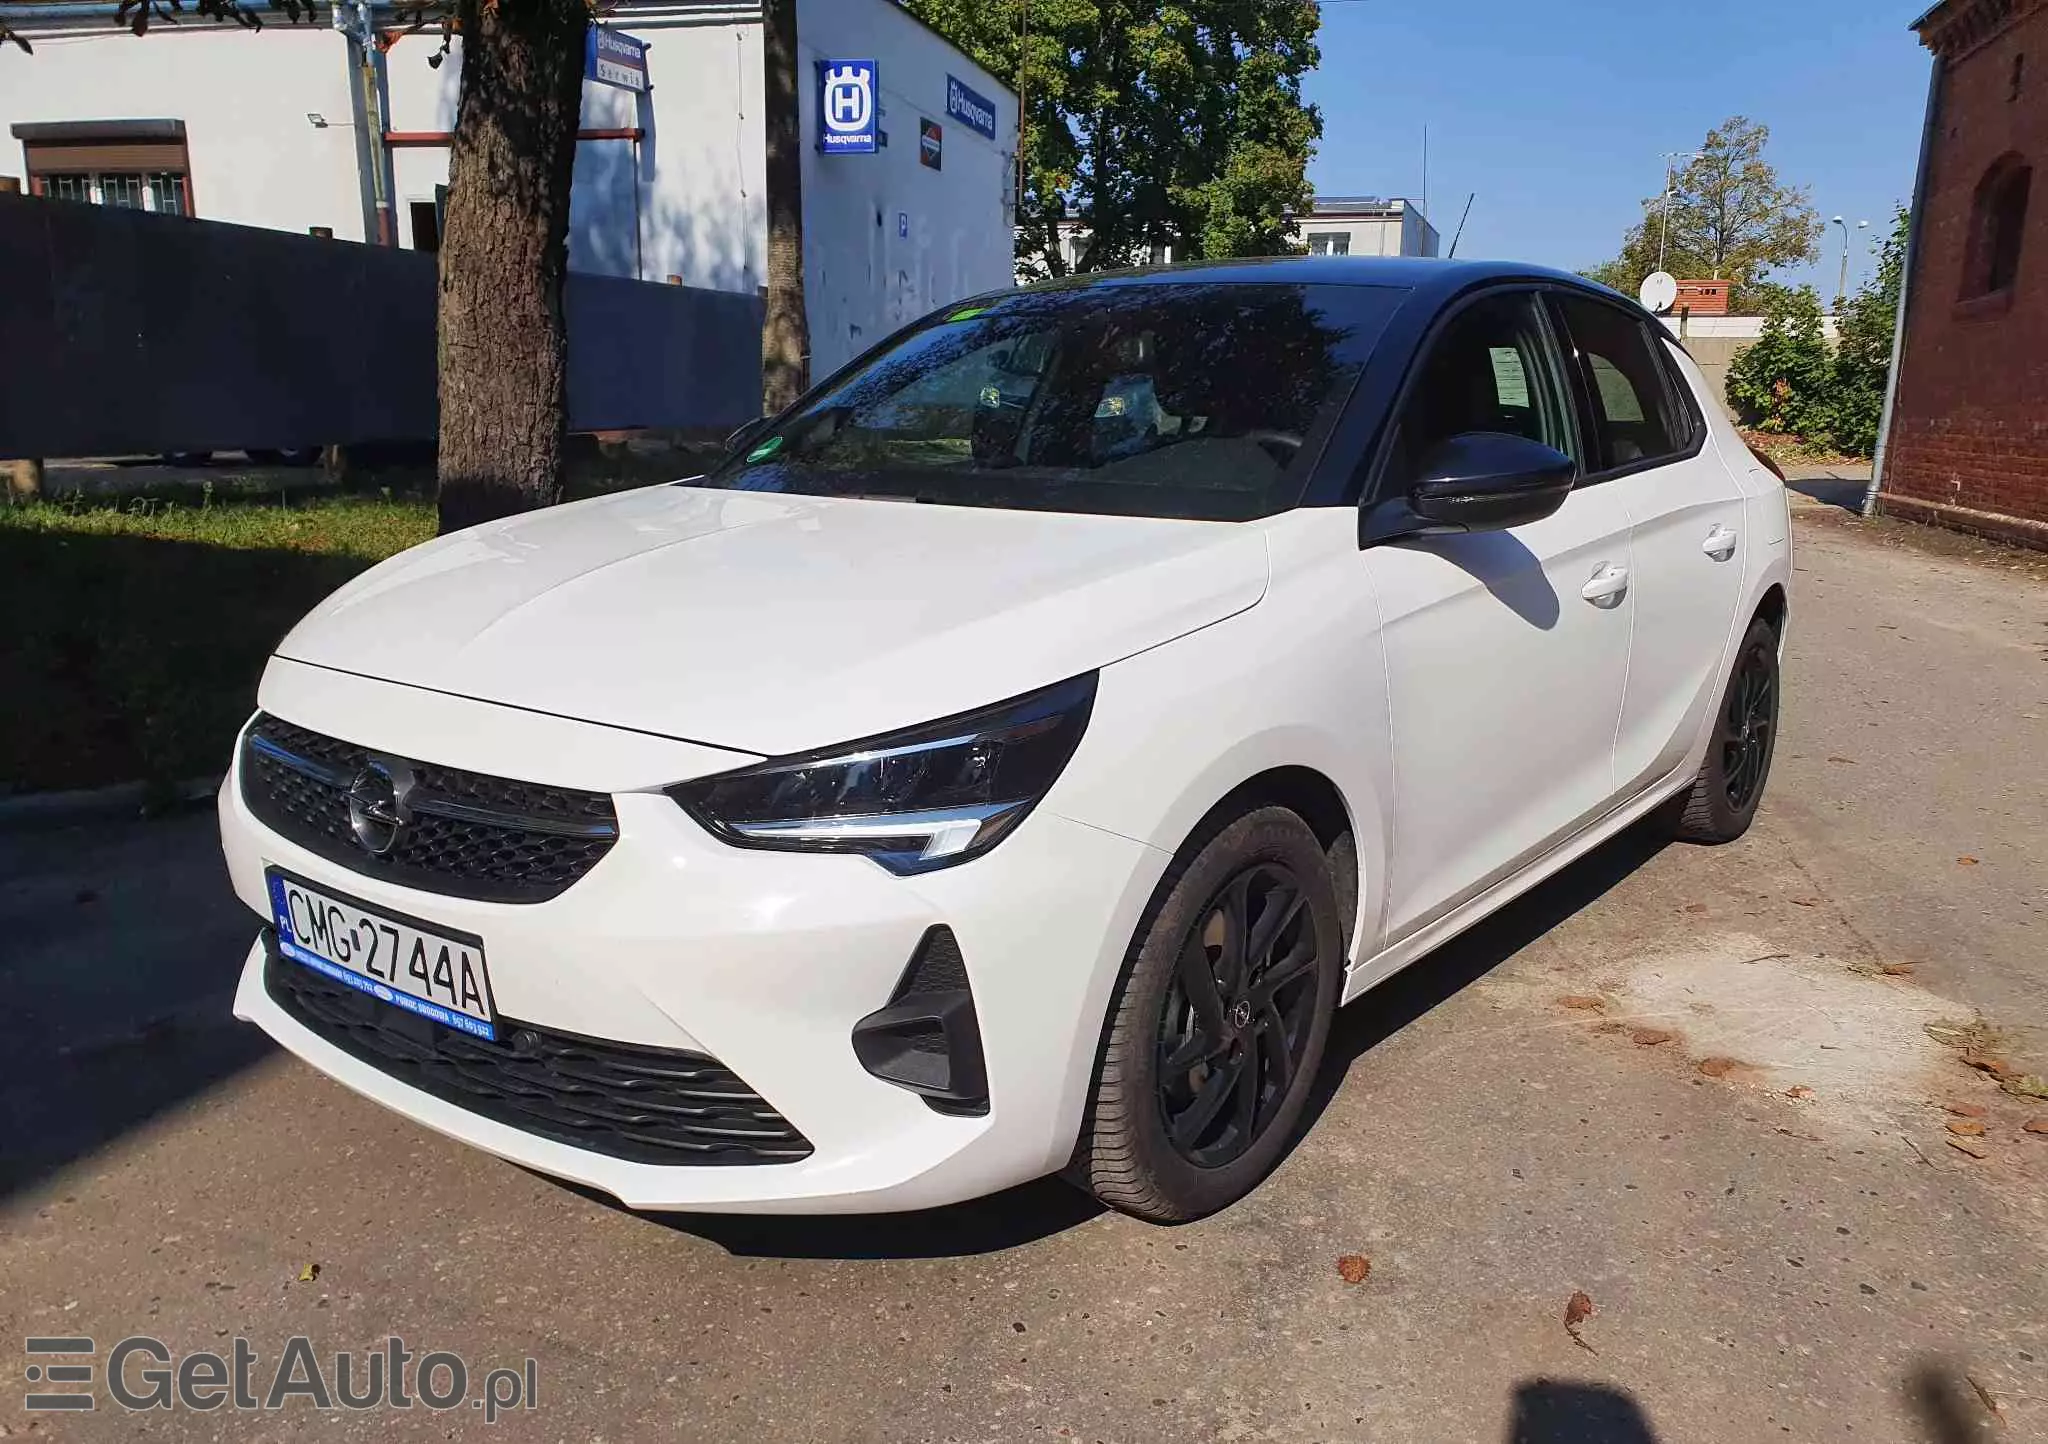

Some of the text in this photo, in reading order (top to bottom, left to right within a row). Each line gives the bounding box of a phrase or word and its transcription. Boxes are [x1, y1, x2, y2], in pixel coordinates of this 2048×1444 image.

[834, 87, 860, 119] H
[957, 89, 993, 131] Husqvarna
[823, 133, 872, 145] Husqvarna
[279, 914, 293, 934] PL
[288, 889, 351, 963] CMG
[358, 918, 485, 1016] 2744A
